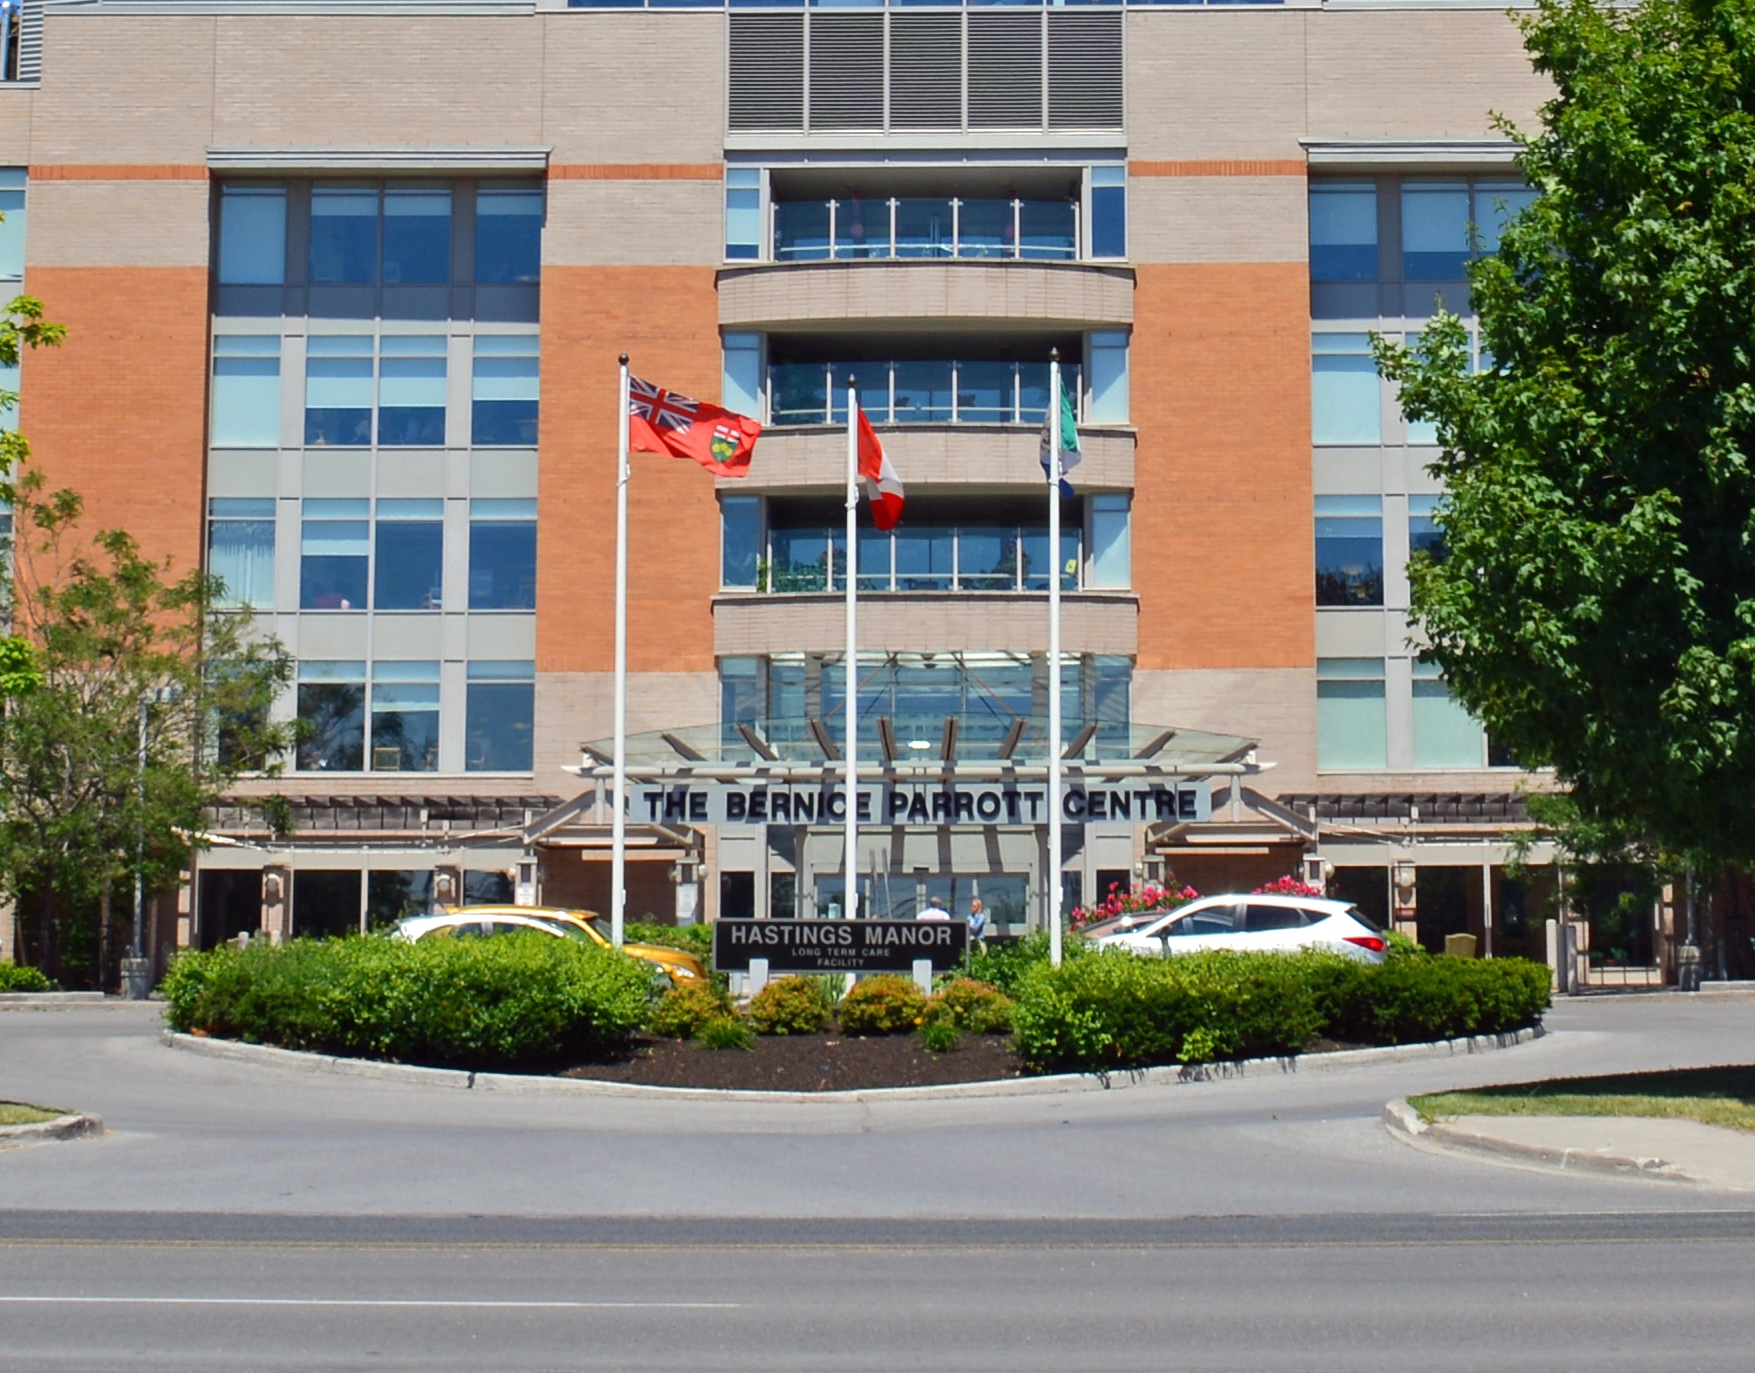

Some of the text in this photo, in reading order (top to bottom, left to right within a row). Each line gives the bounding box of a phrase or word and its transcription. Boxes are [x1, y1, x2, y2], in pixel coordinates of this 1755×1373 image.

[643, 789, 1196, 821] THE BERNICE PARROTT CENTRE
[731, 925, 951, 945] HASTINGS MANOR
[792, 948, 890, 956] LONG TERM CARE
[817, 958, 864, 967] FACILITY
